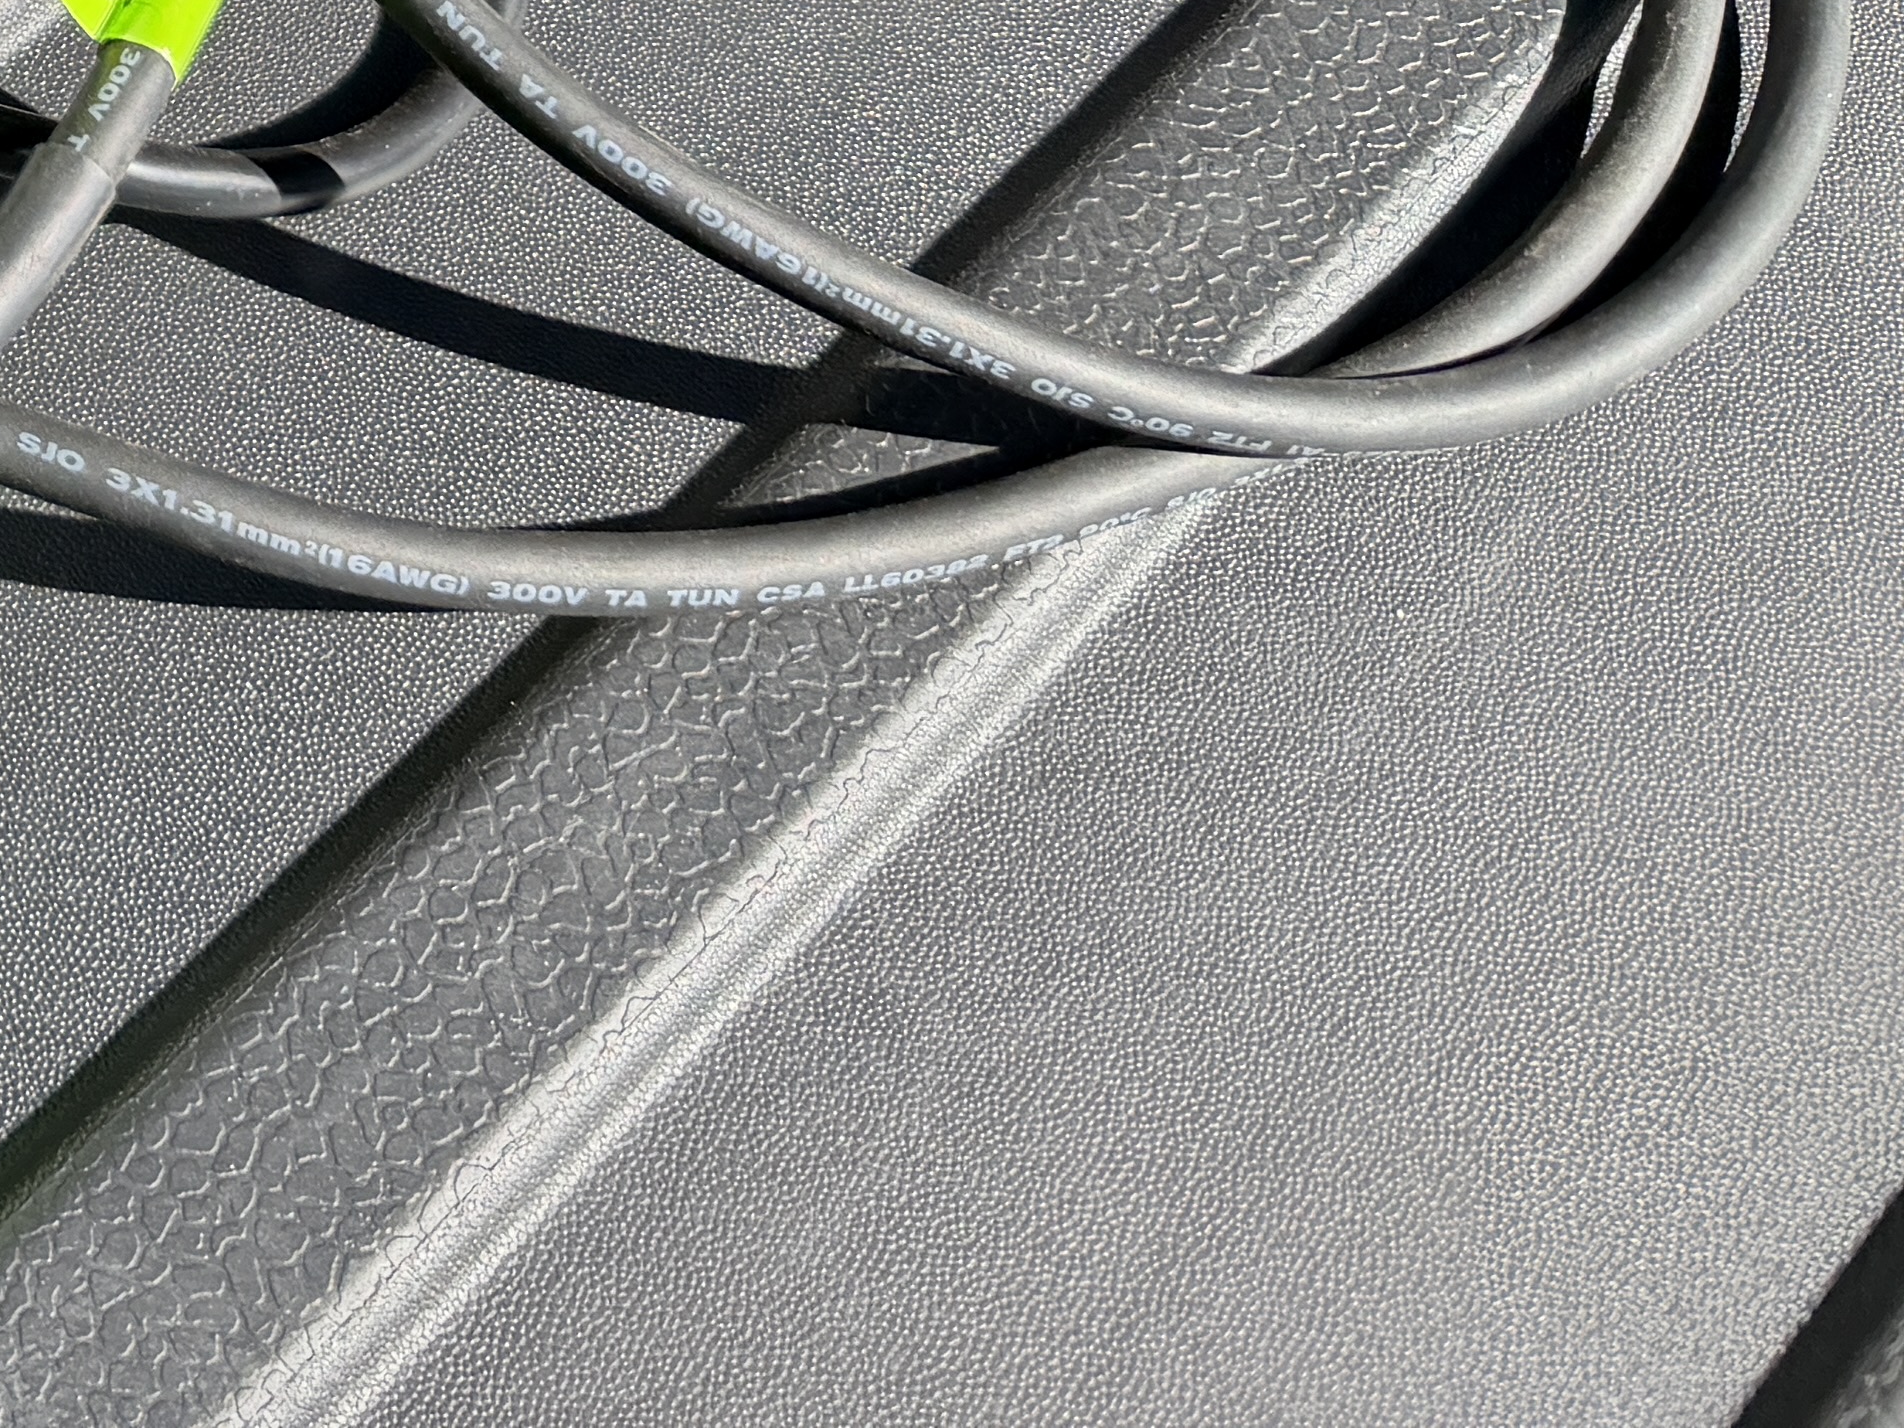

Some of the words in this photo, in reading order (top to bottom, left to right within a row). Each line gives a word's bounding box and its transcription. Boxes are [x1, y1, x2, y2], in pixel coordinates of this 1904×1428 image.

[436, 0, 504, 72] TUN
[87, 47, 142, 122] 300V
[518, 73, 558, 120] TA
[572, 123, 673, 195] 300V
[1030, 377, 1094, 409] SJO
[1106, 405, 1194, 438] 90°C
[1207, 430, 1274, 452] FT2
[15, 430, 87, 473] SJO
[487, 580, 589, 606] 300V
[605, 589, 648, 608] TA
[666, 588, 741, 608] TUN
[756, 580, 826, 605] CSA
[844, 553, 990, 593] LL60382
